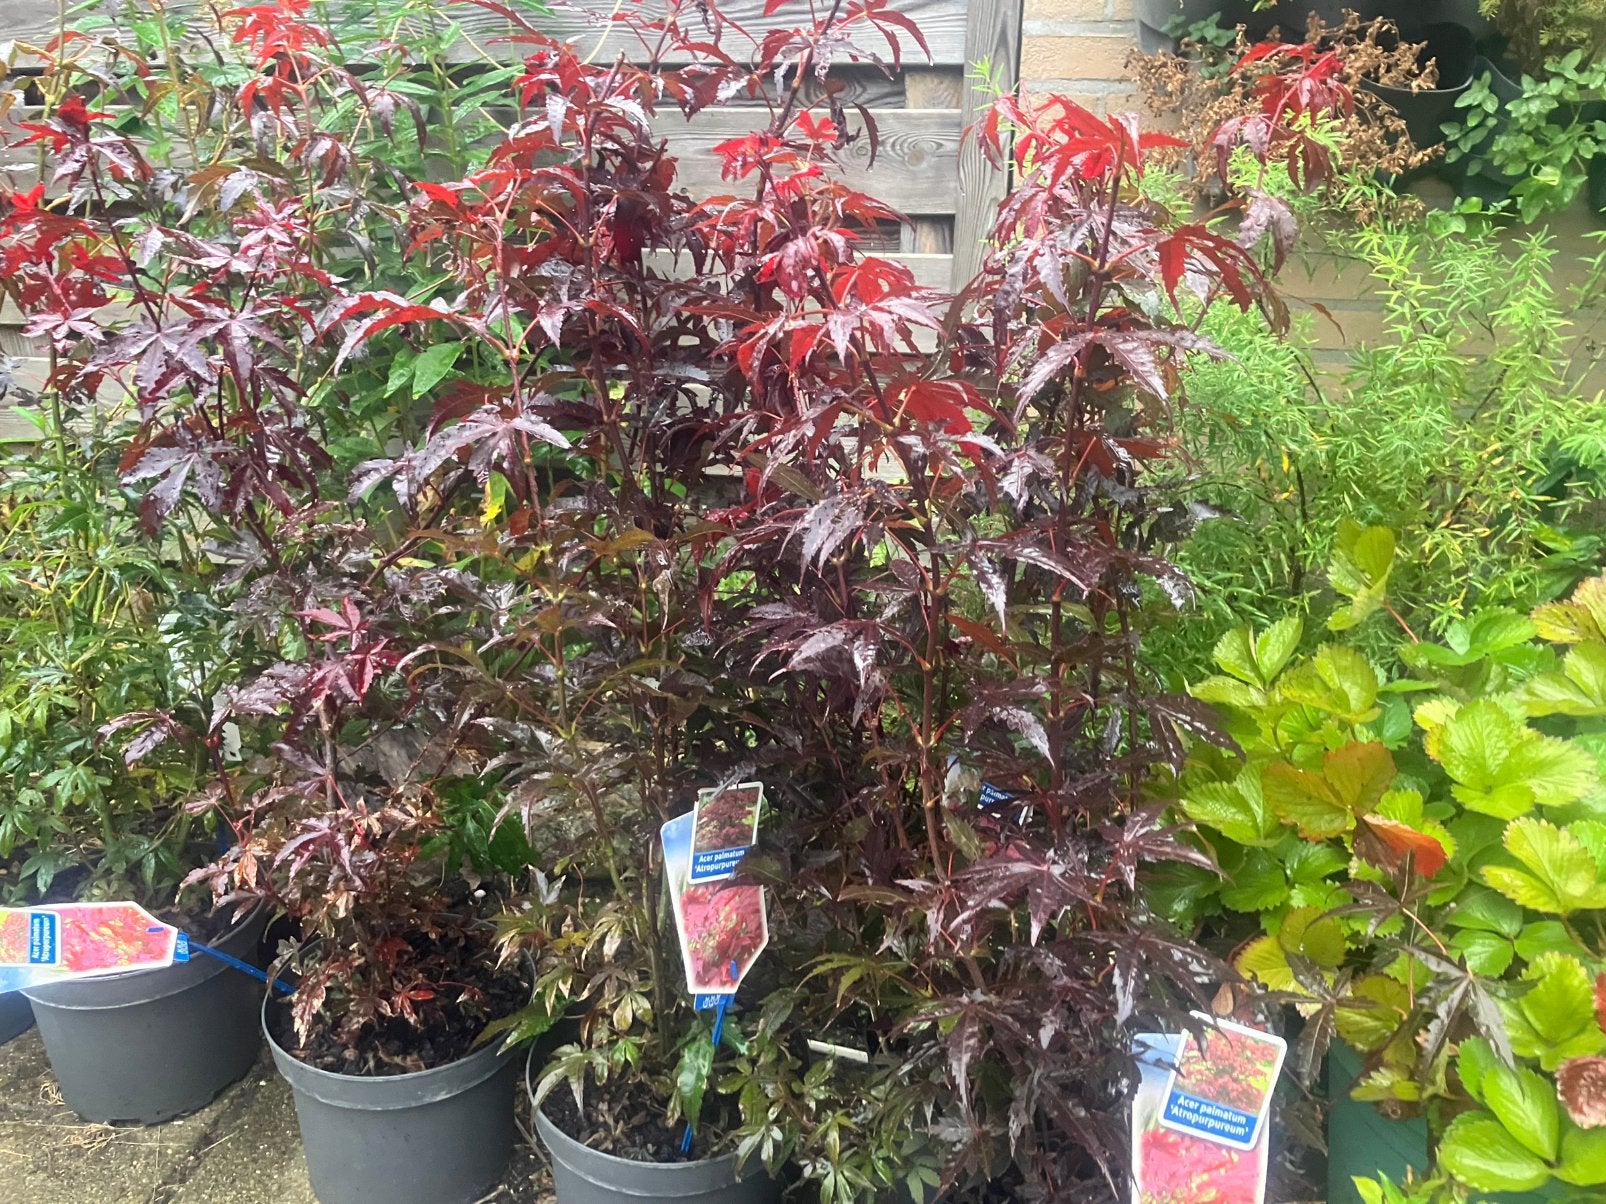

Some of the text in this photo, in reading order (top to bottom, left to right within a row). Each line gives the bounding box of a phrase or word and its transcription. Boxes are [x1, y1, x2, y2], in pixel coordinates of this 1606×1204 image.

[699, 850, 745, 863] Acer palmatum
[31, 945, 40, 959] Acer
[1177, 1095, 1247, 1125] Acer palmatum
